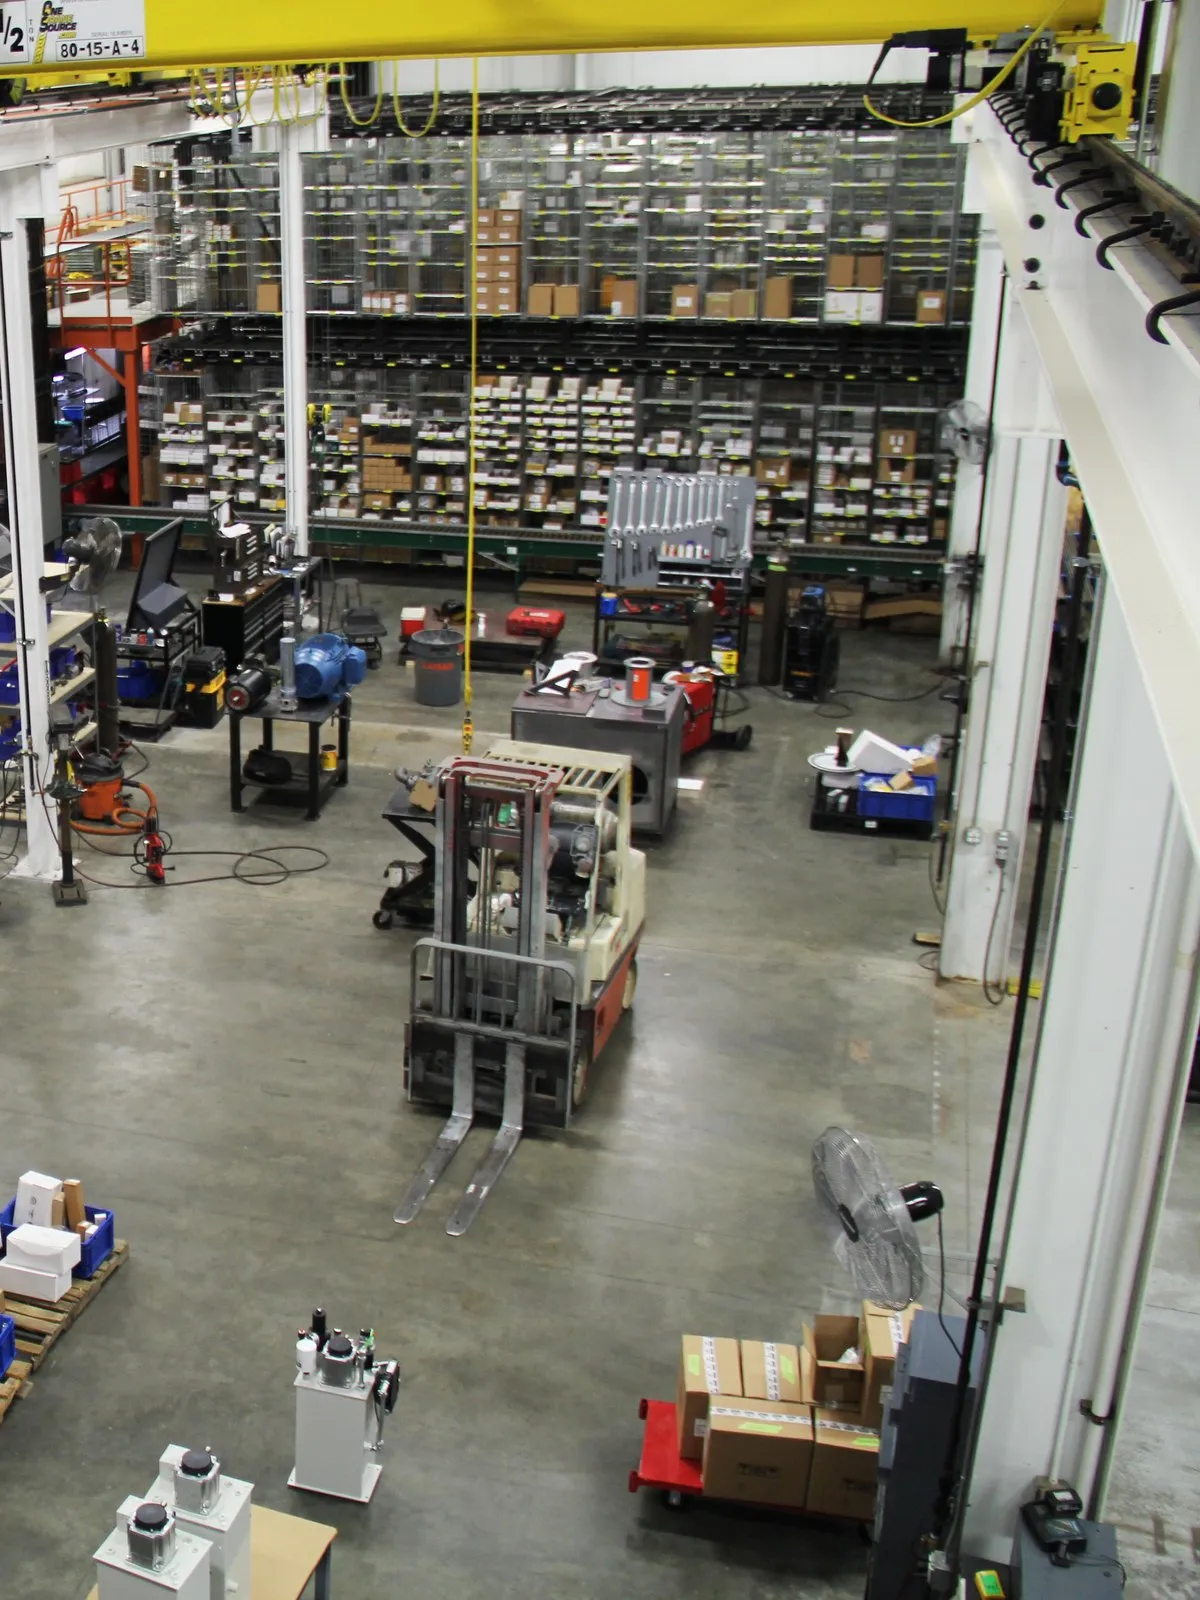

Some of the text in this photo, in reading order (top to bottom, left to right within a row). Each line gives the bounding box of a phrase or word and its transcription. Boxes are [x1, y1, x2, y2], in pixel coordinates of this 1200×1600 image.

[41, 0, 63, 16] ONE
[39, 17, 77, 32] SOURCE
[60, 39, 140, 58] 80-15-A-4
